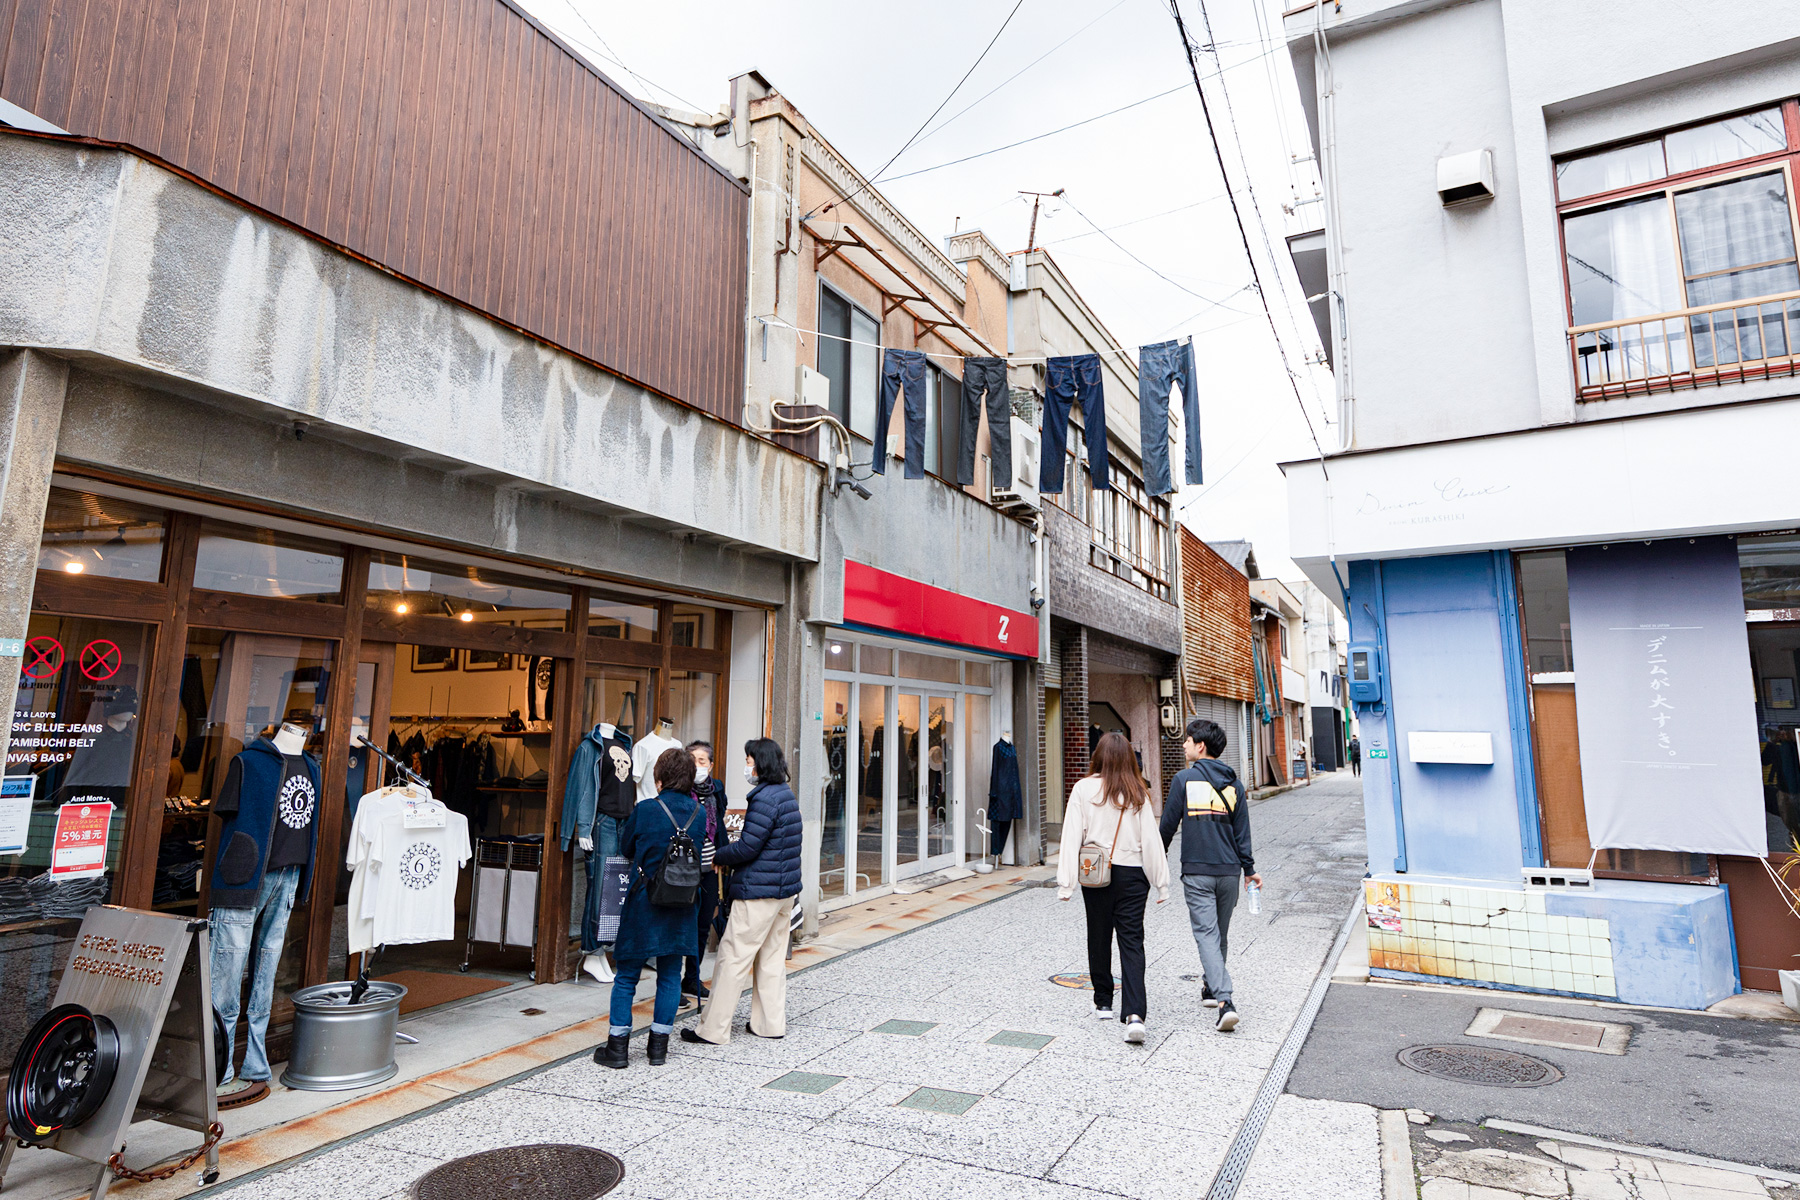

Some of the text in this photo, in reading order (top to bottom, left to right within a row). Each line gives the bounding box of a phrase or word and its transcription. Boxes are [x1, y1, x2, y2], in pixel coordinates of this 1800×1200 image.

[1411, 513, 1466, 525] KURASHIKI
[1647, 635, 1677, 757] デニムが大すき。
[34, 723, 65, 732] BLUE
[67, 723, 103, 734] JEANS
[69, 738, 96, 748] BELT
[40, 753, 65, 762] BAG
[414, 857, 424, 874] 6
[80, 933, 166, 962] STEEL WHEEL
[72, 955, 163, 986] ENGINEERING
